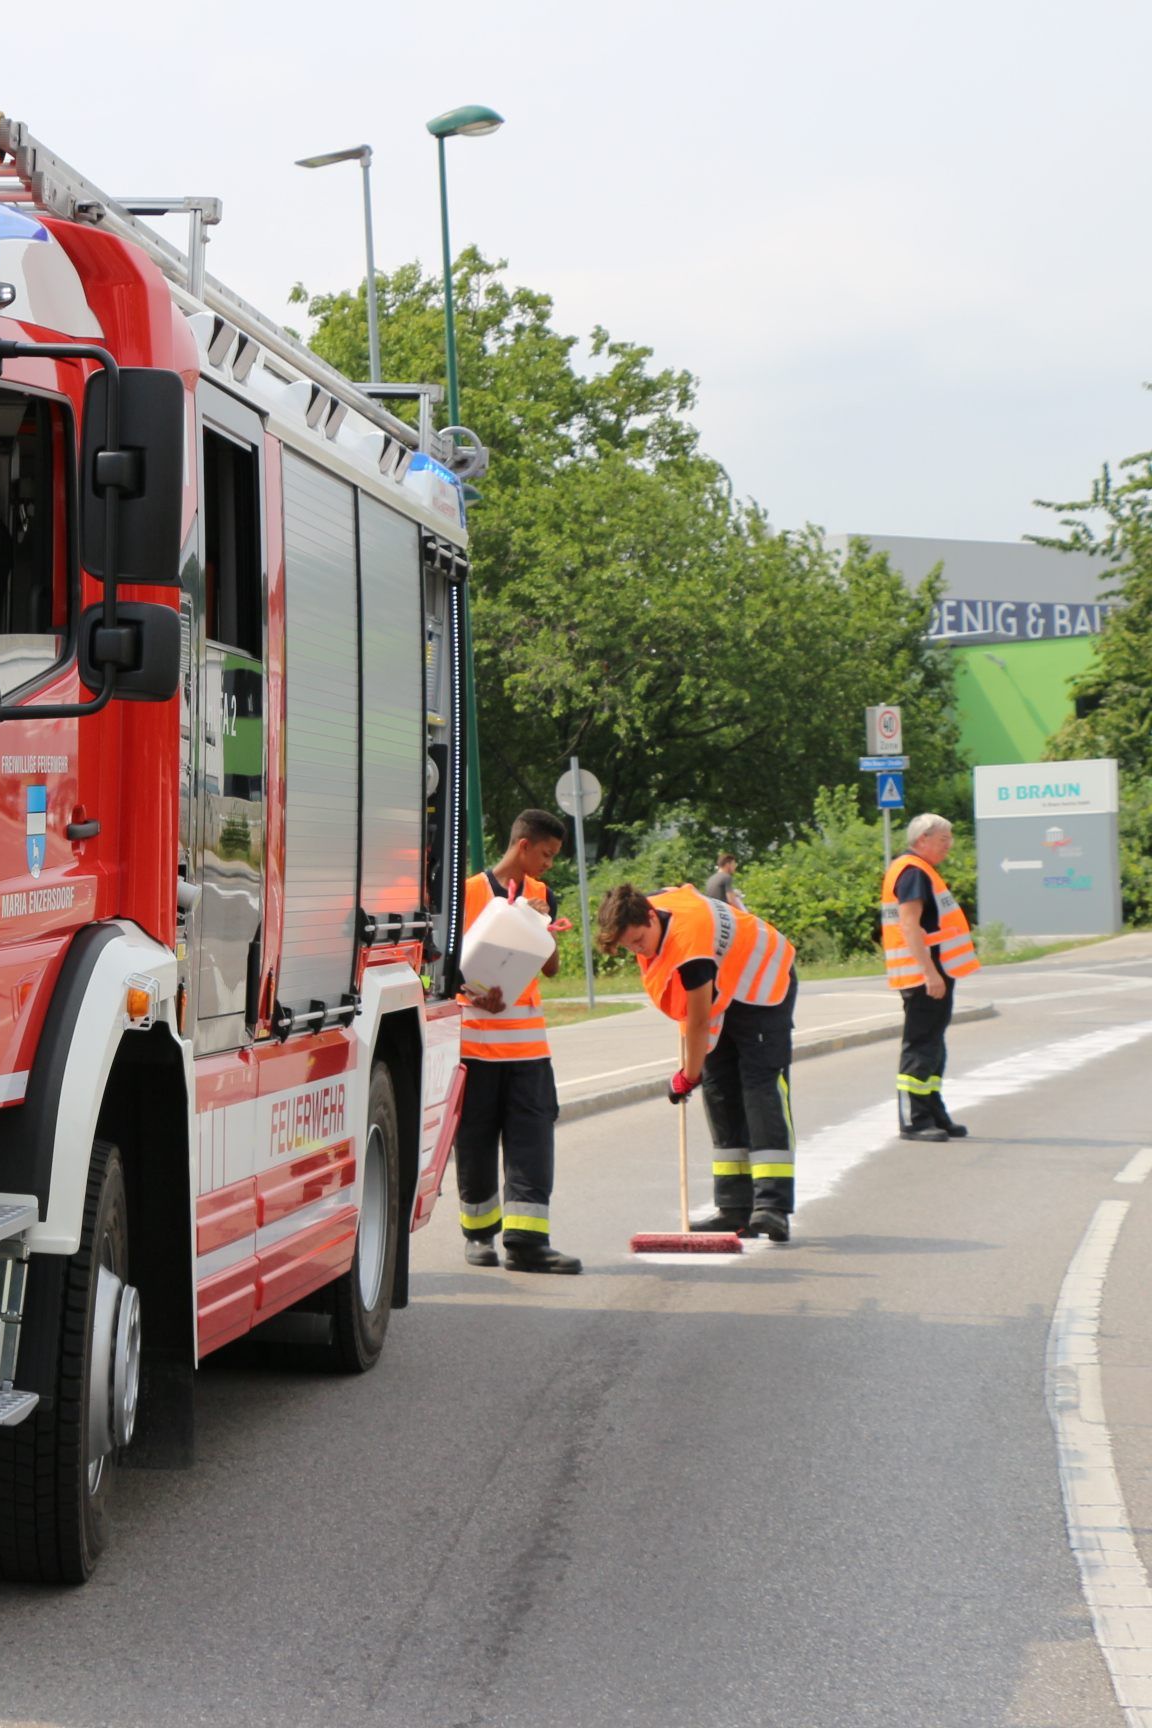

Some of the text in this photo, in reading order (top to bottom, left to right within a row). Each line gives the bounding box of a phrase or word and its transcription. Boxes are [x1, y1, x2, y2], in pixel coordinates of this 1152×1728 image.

[1026, 603, 1046, 638] &
[1, 755, 69, 774] FREIWILLIGE FEUERWEHR
[1016, 783, 1081, 800] BRAUN
[1, 886, 76, 919] MARIA ENZERSDORF
[270, 1083, 345, 1157] FEUERWEHR
